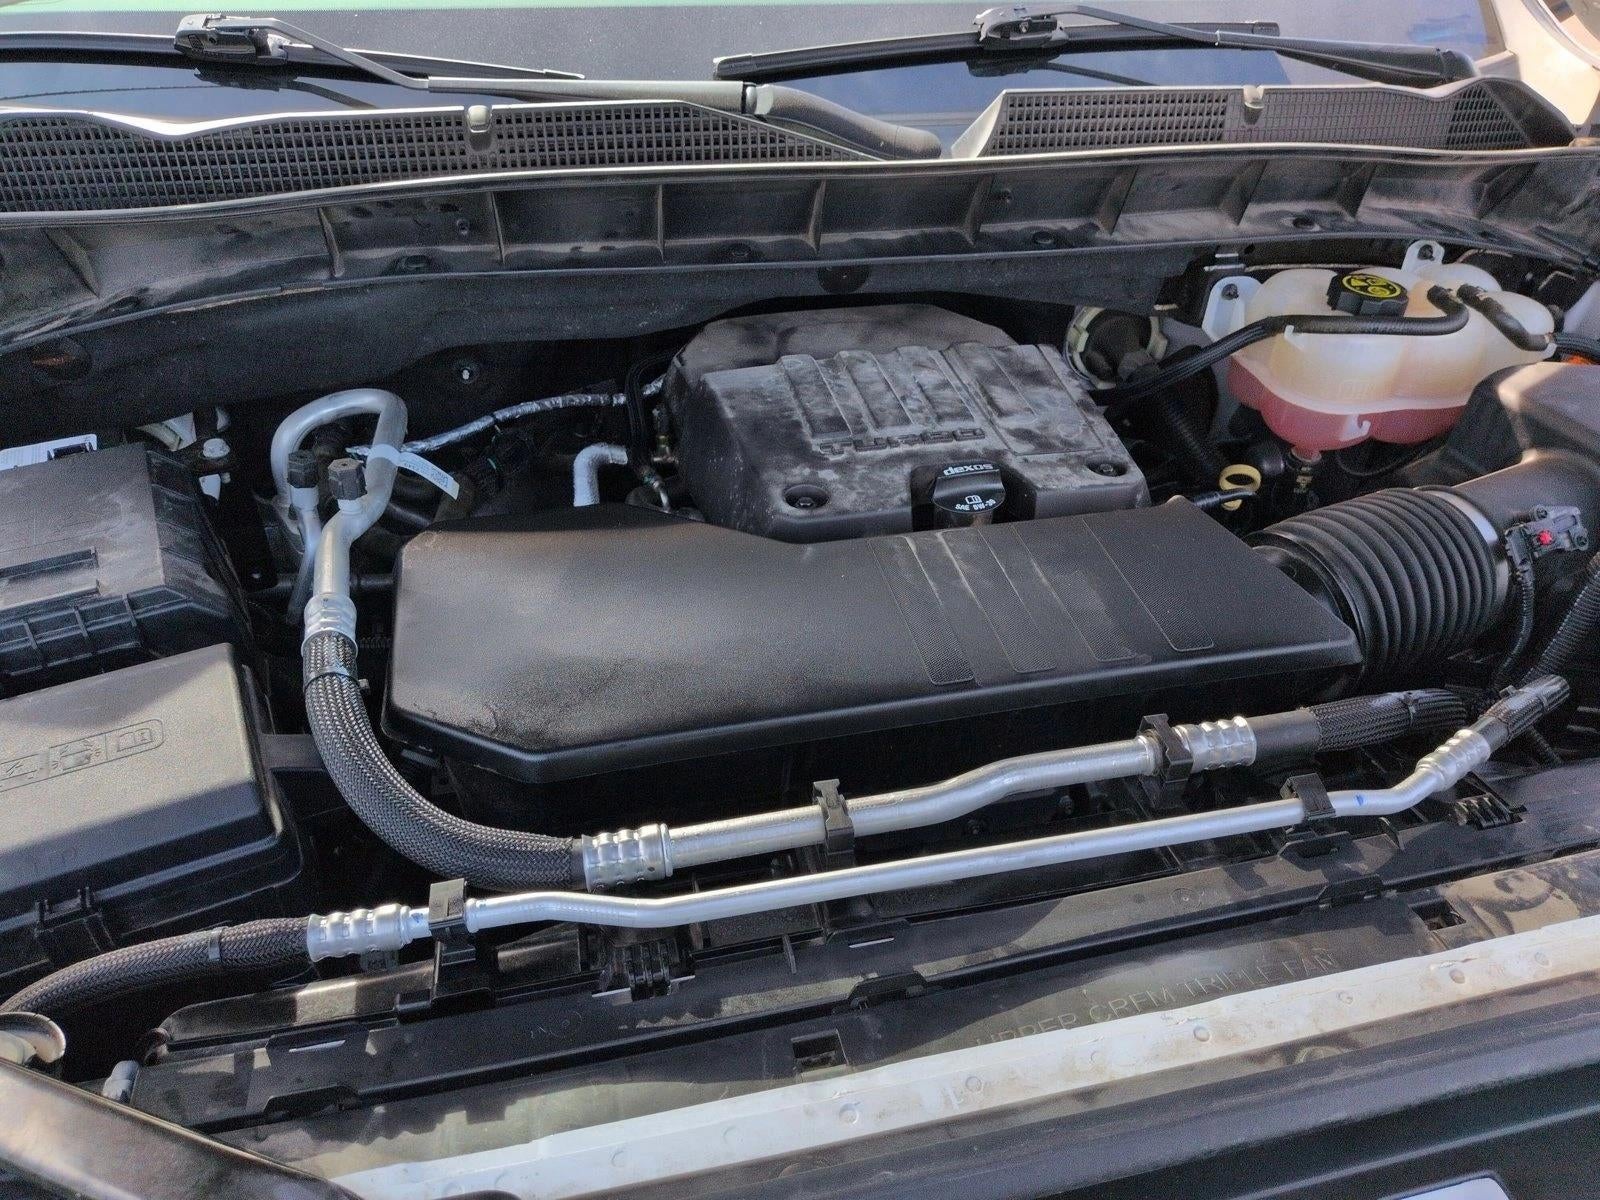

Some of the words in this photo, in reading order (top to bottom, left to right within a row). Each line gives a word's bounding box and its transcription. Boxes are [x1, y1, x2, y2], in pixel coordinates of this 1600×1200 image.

[819, 428, 986, 456] TURBO
[943, 463, 994, 476] dexos
[955, 503, 970, 511] SAE
[976, 1012, 1077, 1046] PPER
[1281, 951, 1339, 978] FAN
